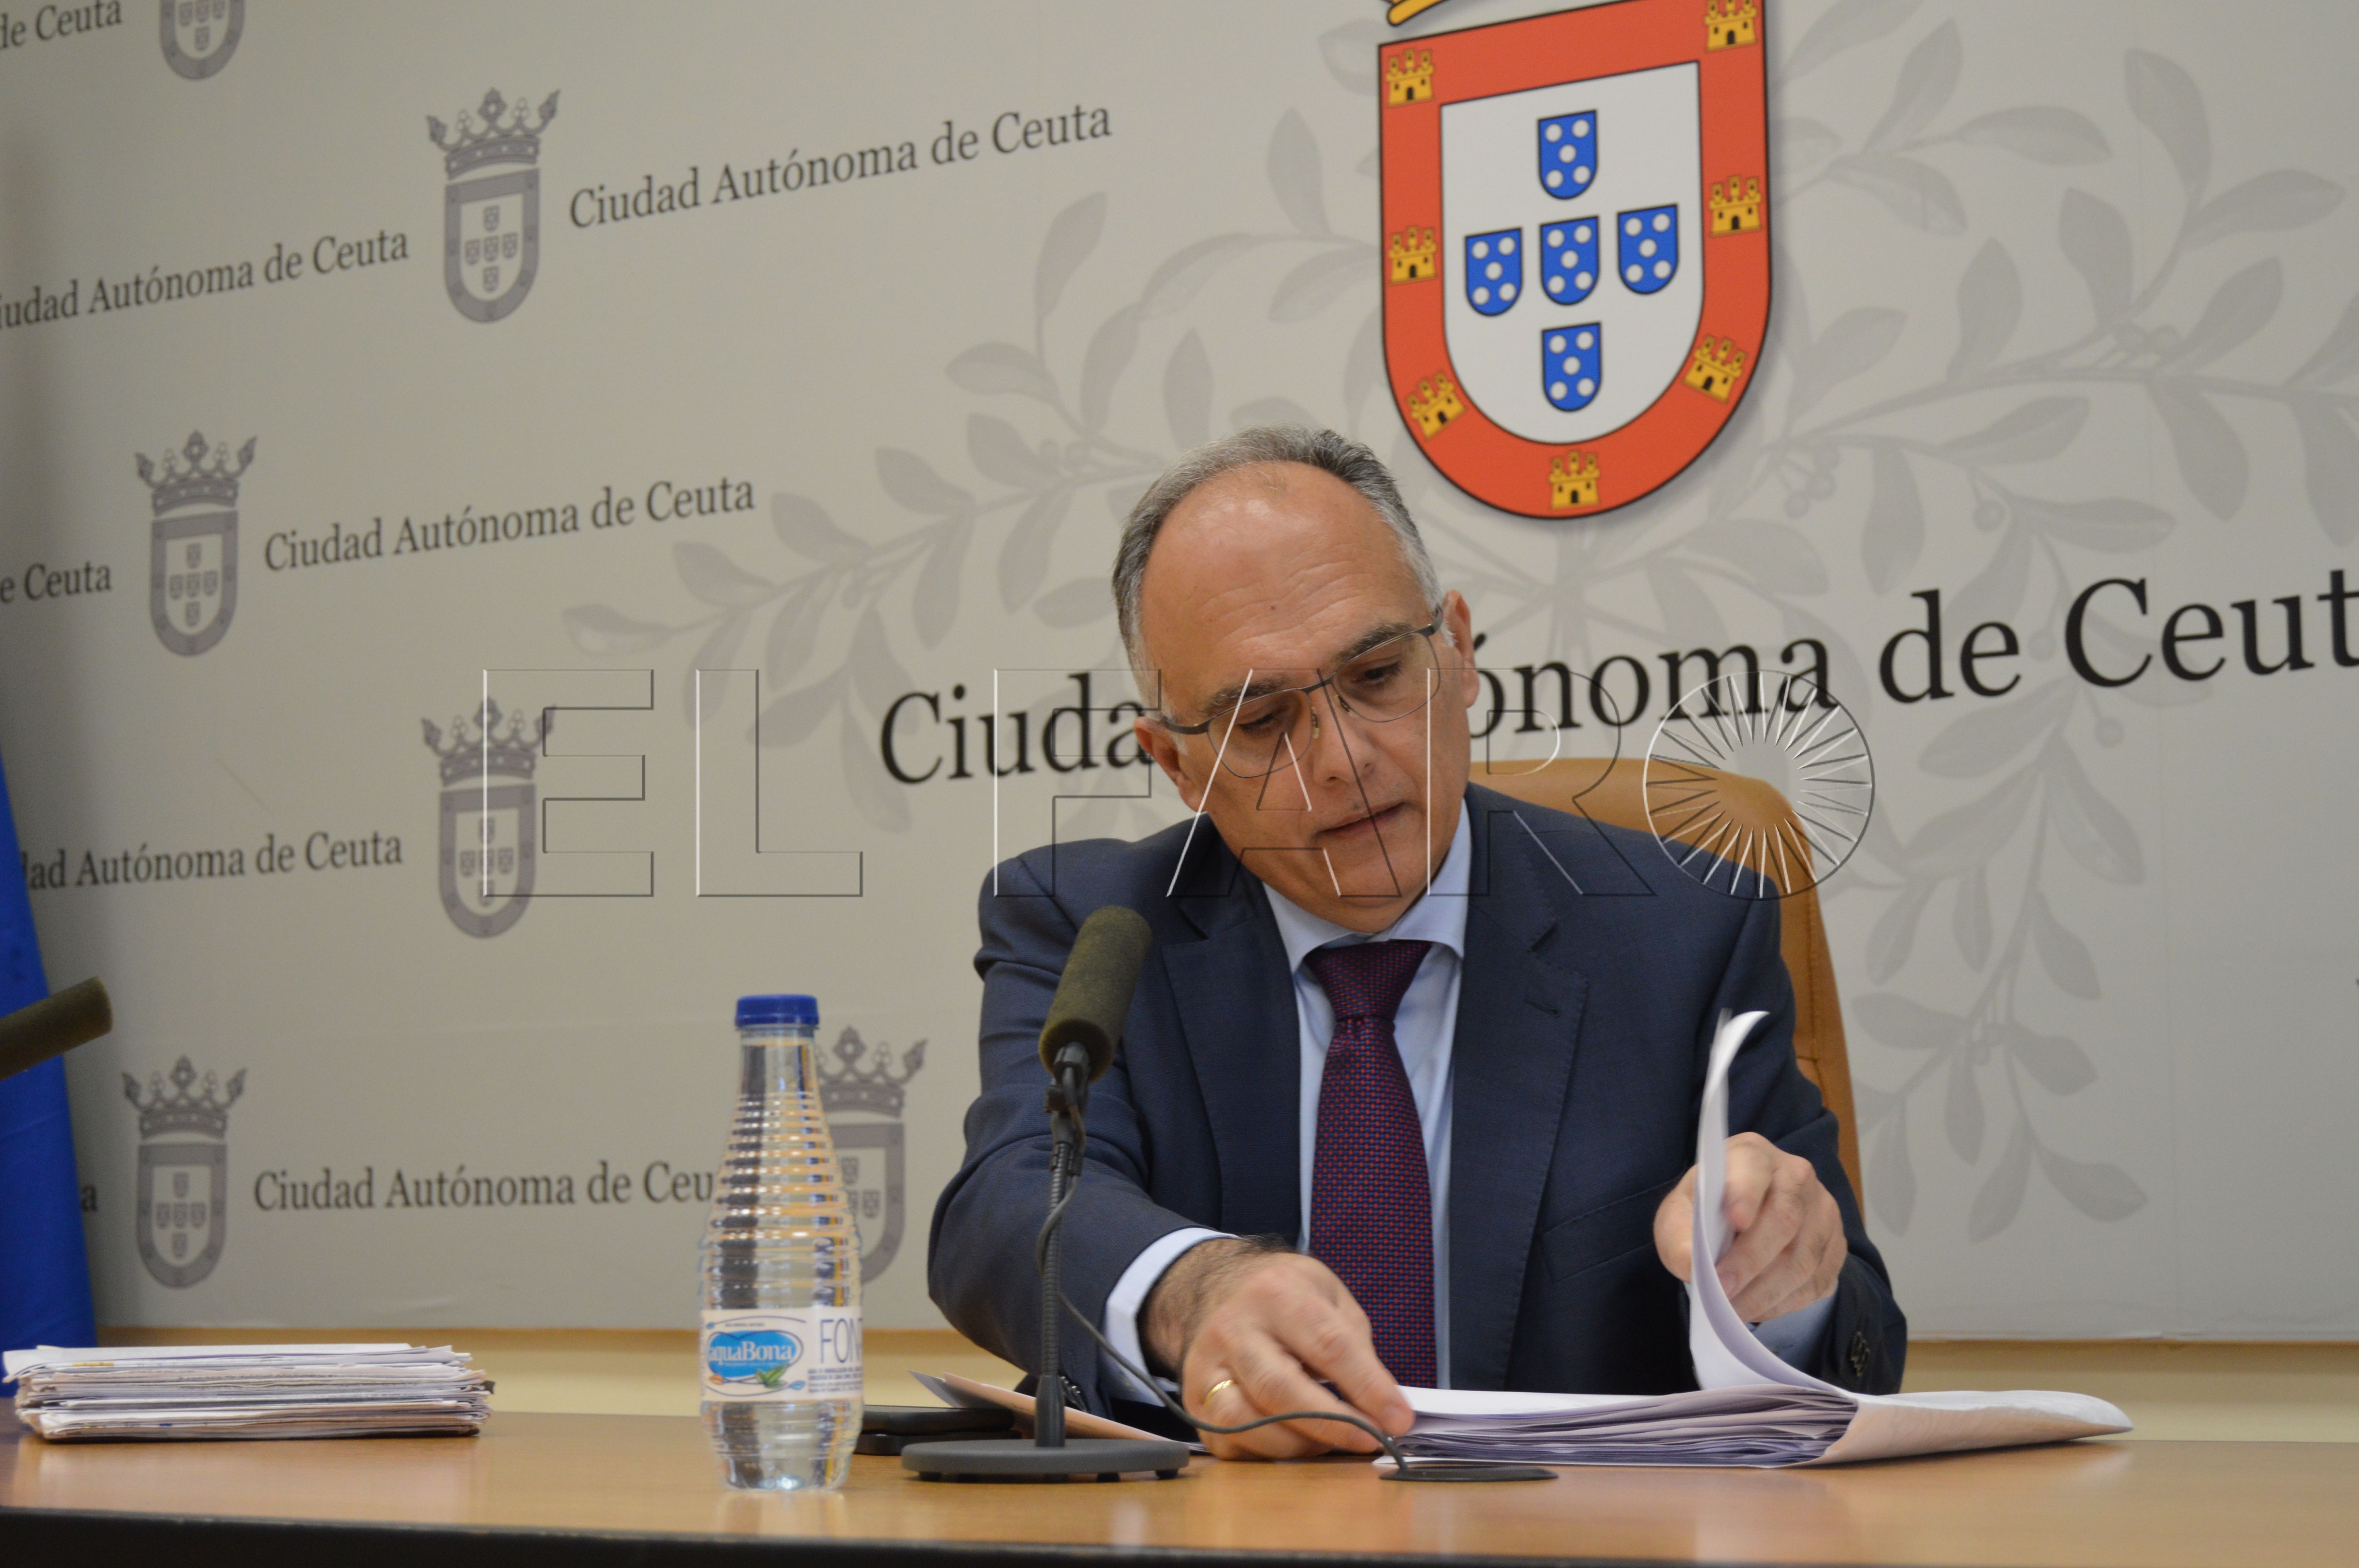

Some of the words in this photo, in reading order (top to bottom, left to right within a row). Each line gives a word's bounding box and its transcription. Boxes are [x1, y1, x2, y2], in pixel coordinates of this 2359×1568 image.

[35, 0, 122, 41] Ceuta
[569, 166, 701, 228] Ciudad
[712, 140, 918, 204] Autónoma
[931, 120, 979, 165] de
[992, 105, 1111, 154] Ceuta
[0, 279, 79, 329] udad
[87, 261, 254, 314] Autónoma
[264, 242, 303, 283] de
[312, 230, 409, 274] Ceuta
[264, 517, 383, 572] Ciudad
[393, 505, 580, 555] Autónoma
[591, 486, 634, 529] de
[646, 477, 754, 522] Ceuta
[23, 561, 112, 601] Ceuta
[881, 671, 1154, 785] Ciuda
[1470, 632, 1840, 739] ónoma
[1879, 588, 2021, 704] de
[2065, 569, 2359, 688] Ceut
[75, 843, 245, 887] Autónoma
[255, 833, 295, 875] de
[305, 831, 402, 871] Ceuta
[253, 1166, 374, 1211] Ciudad
[385, 1165, 575, 1208] Autónoma
[587, 1160, 631, 1204] de
[643, 1161, 713, 1203] Ceu
